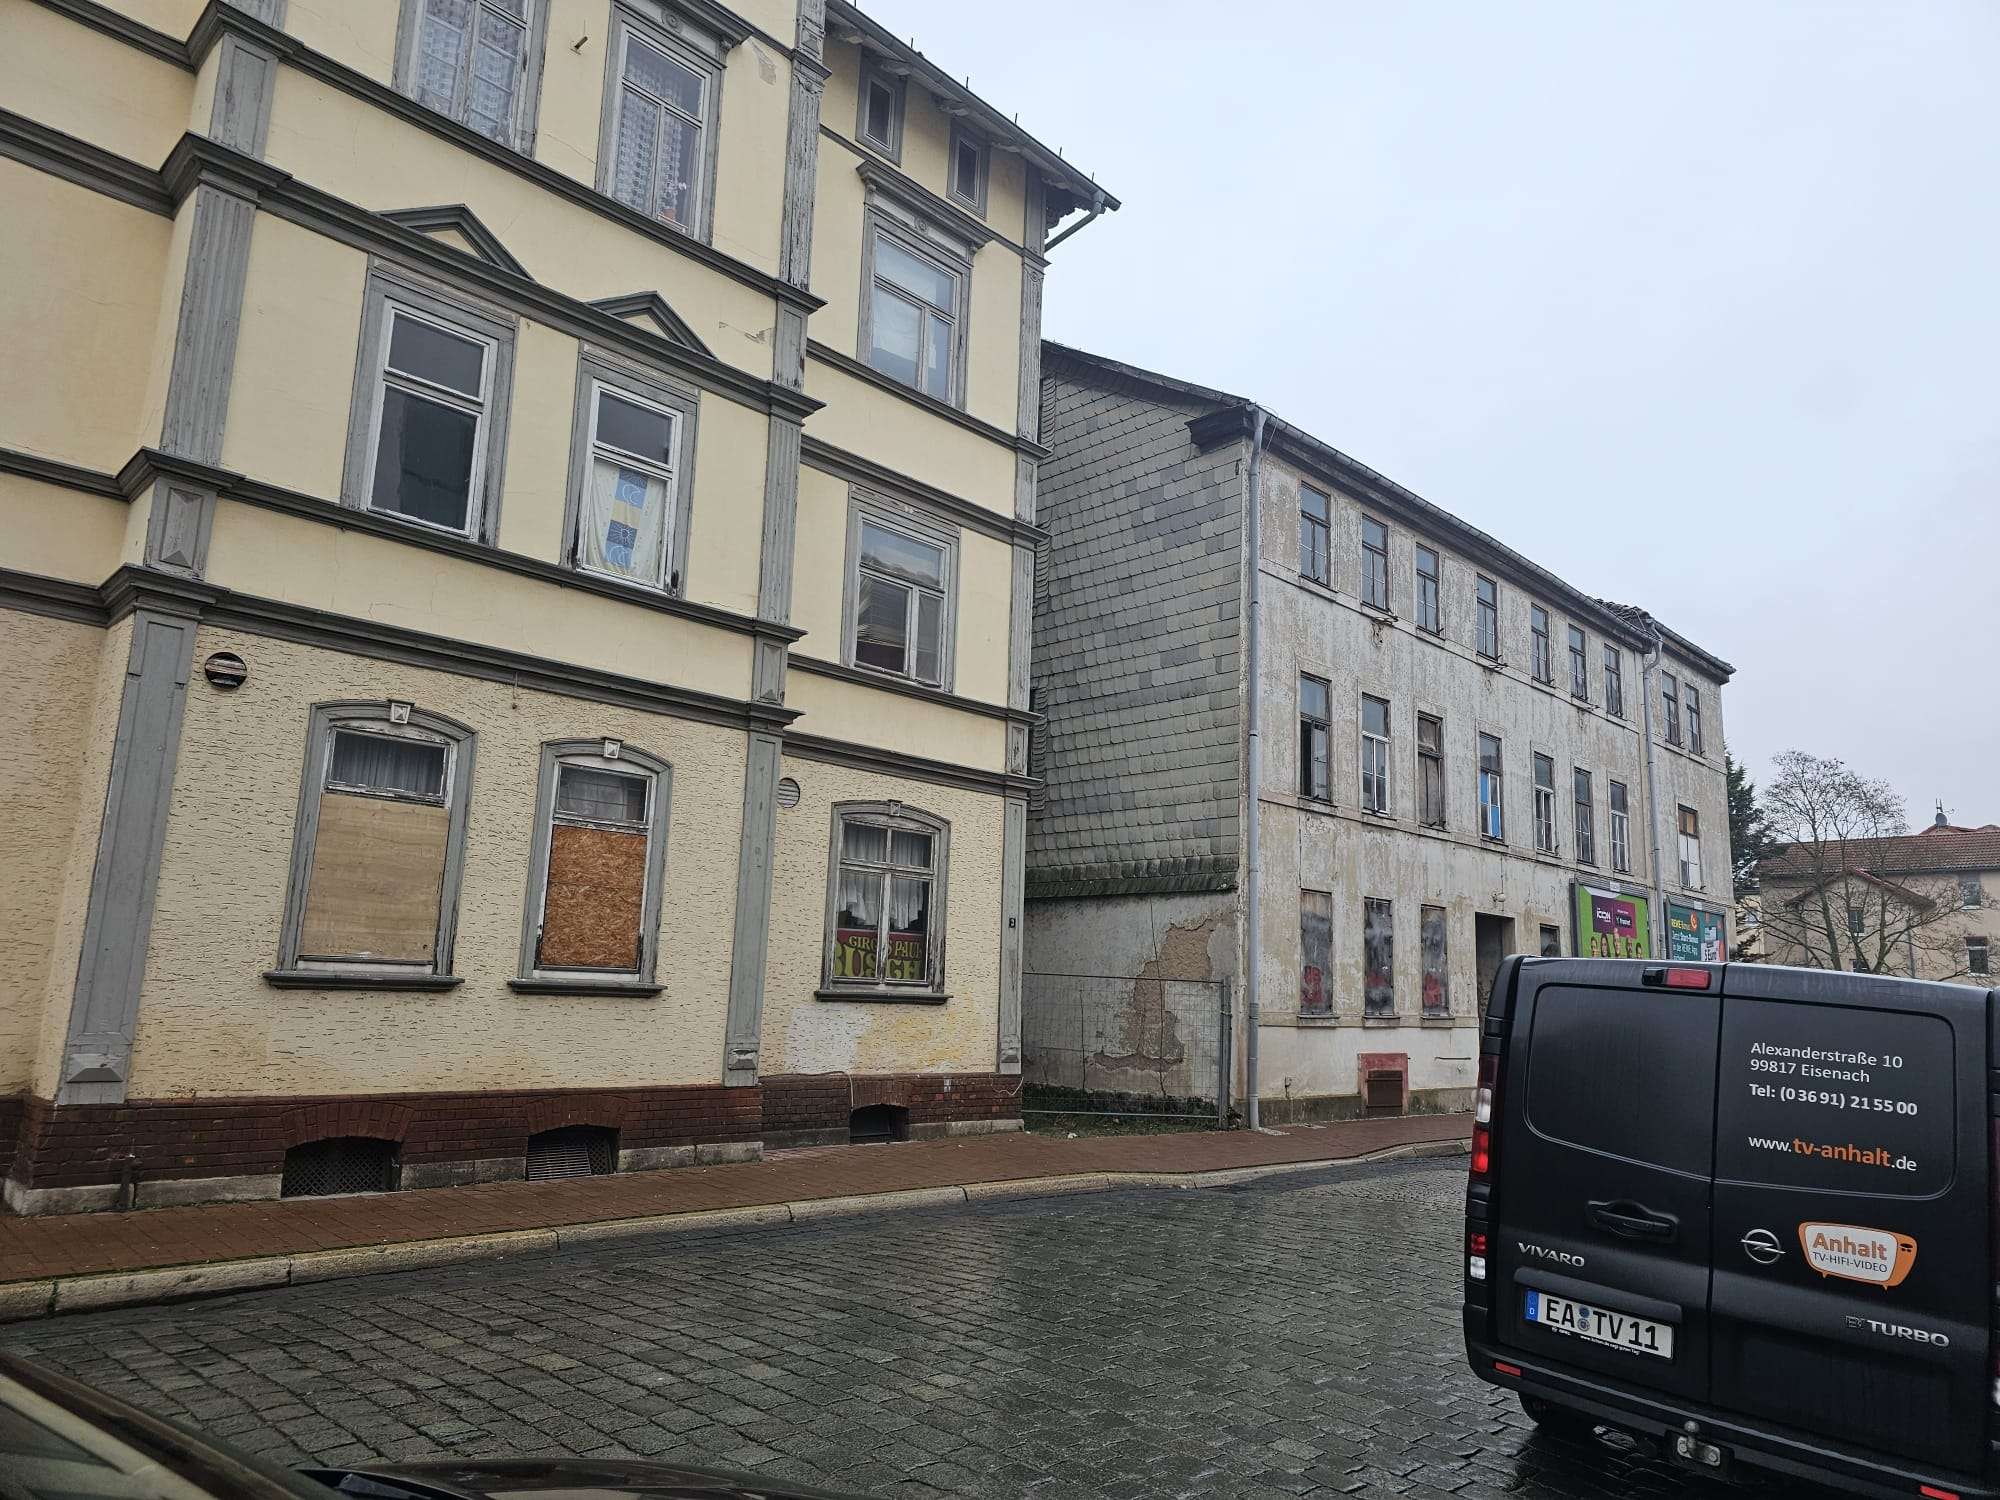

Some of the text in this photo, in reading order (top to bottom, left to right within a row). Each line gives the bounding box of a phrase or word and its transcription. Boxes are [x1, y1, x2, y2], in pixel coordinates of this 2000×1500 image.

[1751, 1042, 1903, 1069] Alexanderstraße 10
[1750, 1059, 1870, 1083] 99817 Eisenach
[1749, 1083, 1776, 1098] Tel:
[1748, 1136, 1917, 1172] www.tv-anhalt.de
[1518, 1242, 1585, 1267] VIVARO
[1812, 1232, 1888, 1260] Anhalt
[1812, 1251, 1888, 1273] TV-HIFI-VIDEO
[1545, 1298, 1575, 1329] EA
